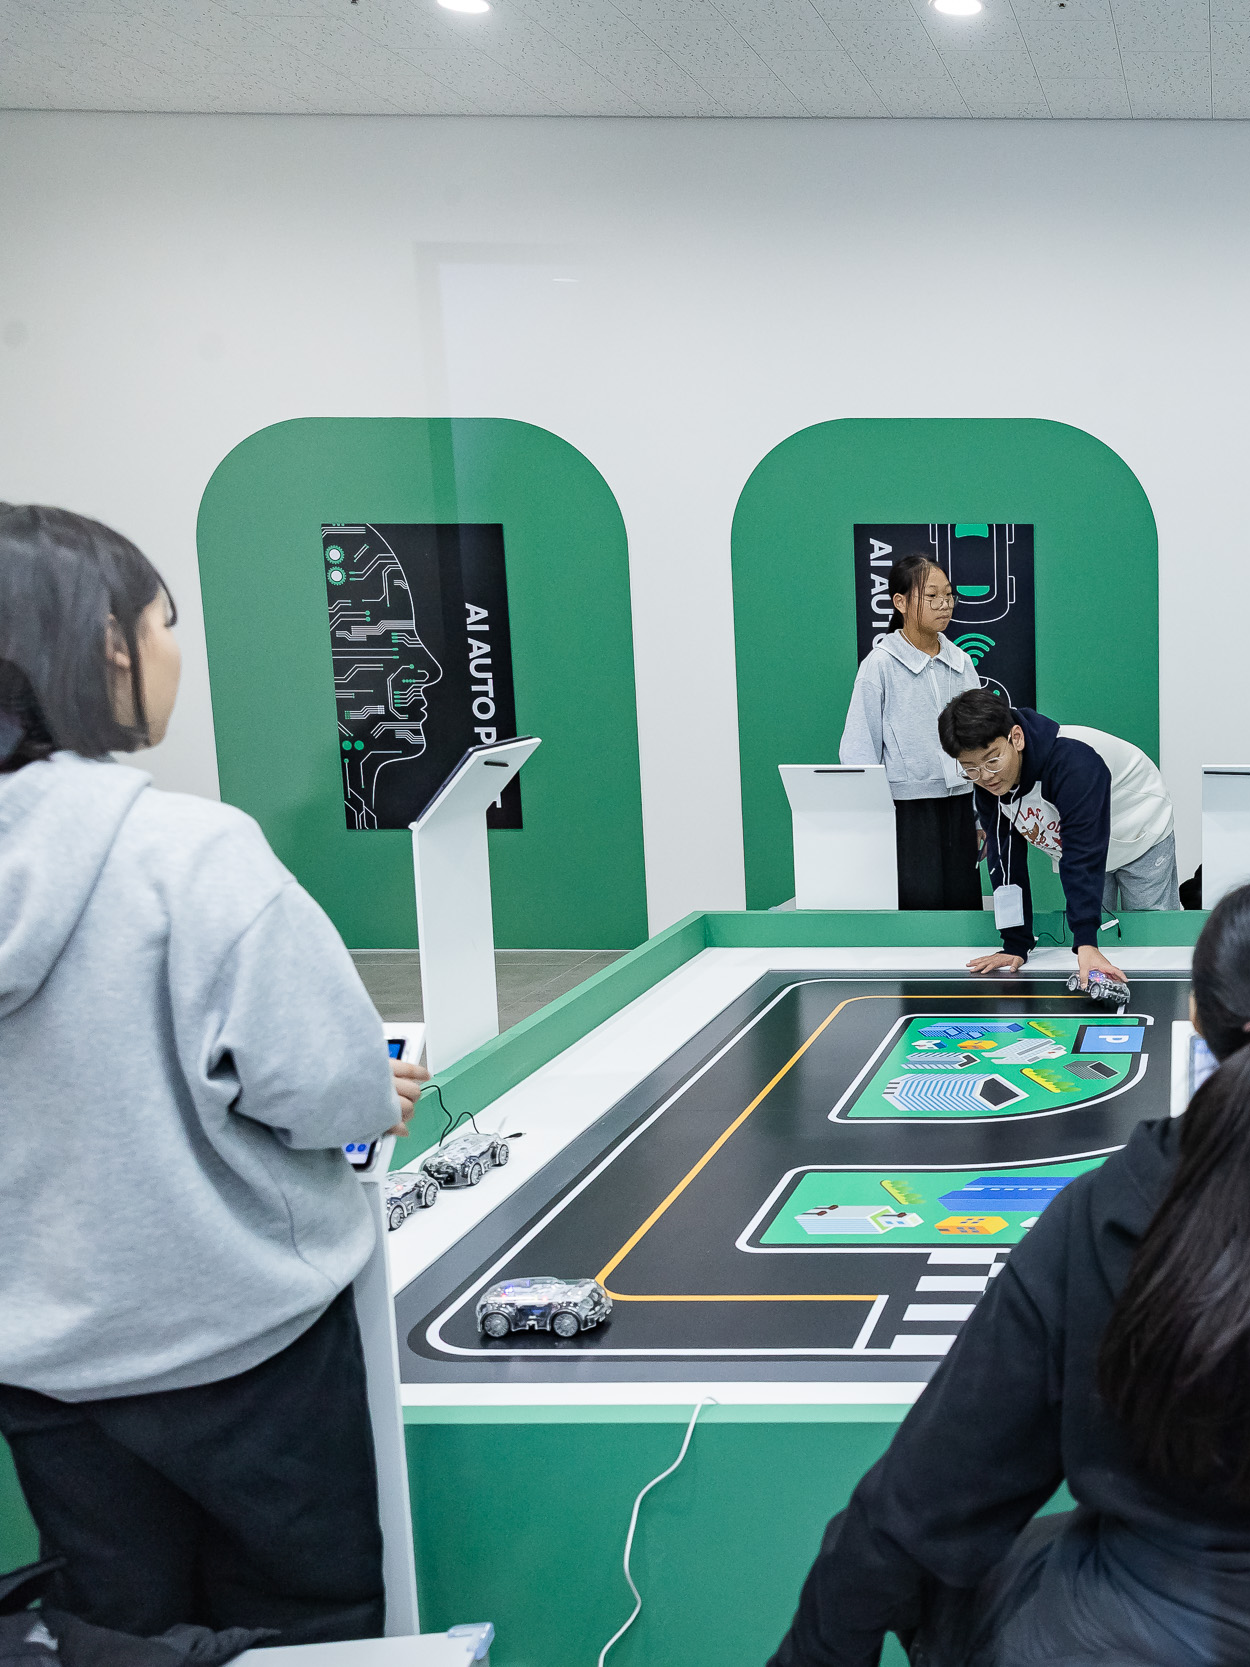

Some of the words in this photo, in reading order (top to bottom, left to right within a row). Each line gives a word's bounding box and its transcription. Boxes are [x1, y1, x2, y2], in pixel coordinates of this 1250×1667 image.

[869, 538, 893, 566] AI
[465, 602, 489, 631] AI
[467, 637, 495, 720] AUTO
[1098, 1035, 1129, 1044] P
